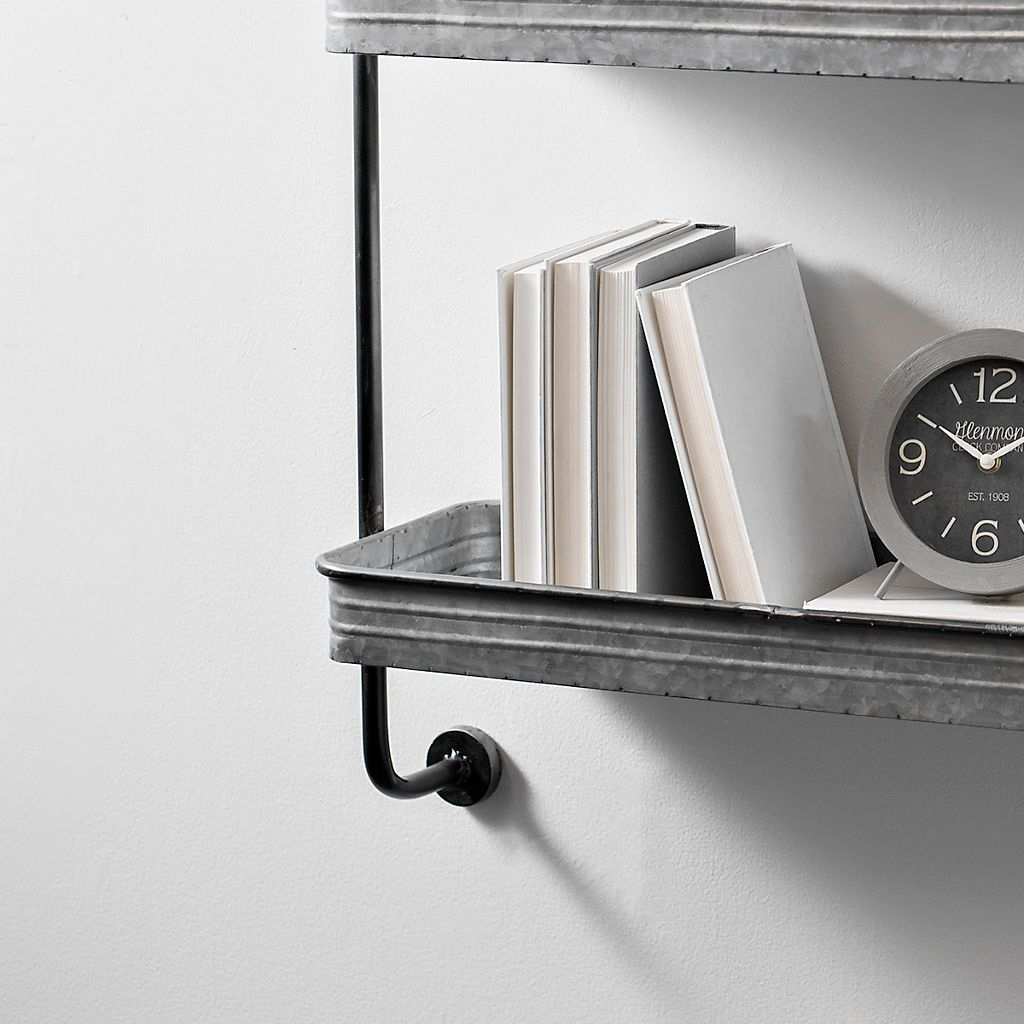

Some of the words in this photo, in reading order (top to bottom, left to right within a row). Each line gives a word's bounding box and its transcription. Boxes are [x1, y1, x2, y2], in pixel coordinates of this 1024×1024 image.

[973, 367, 1017, 404] 12
[898, 438, 927, 475] 9
[968, 492, 985, 501] EST.
[989, 492, 1010, 502] 1908
[970, 519, 1000, 557] 6
